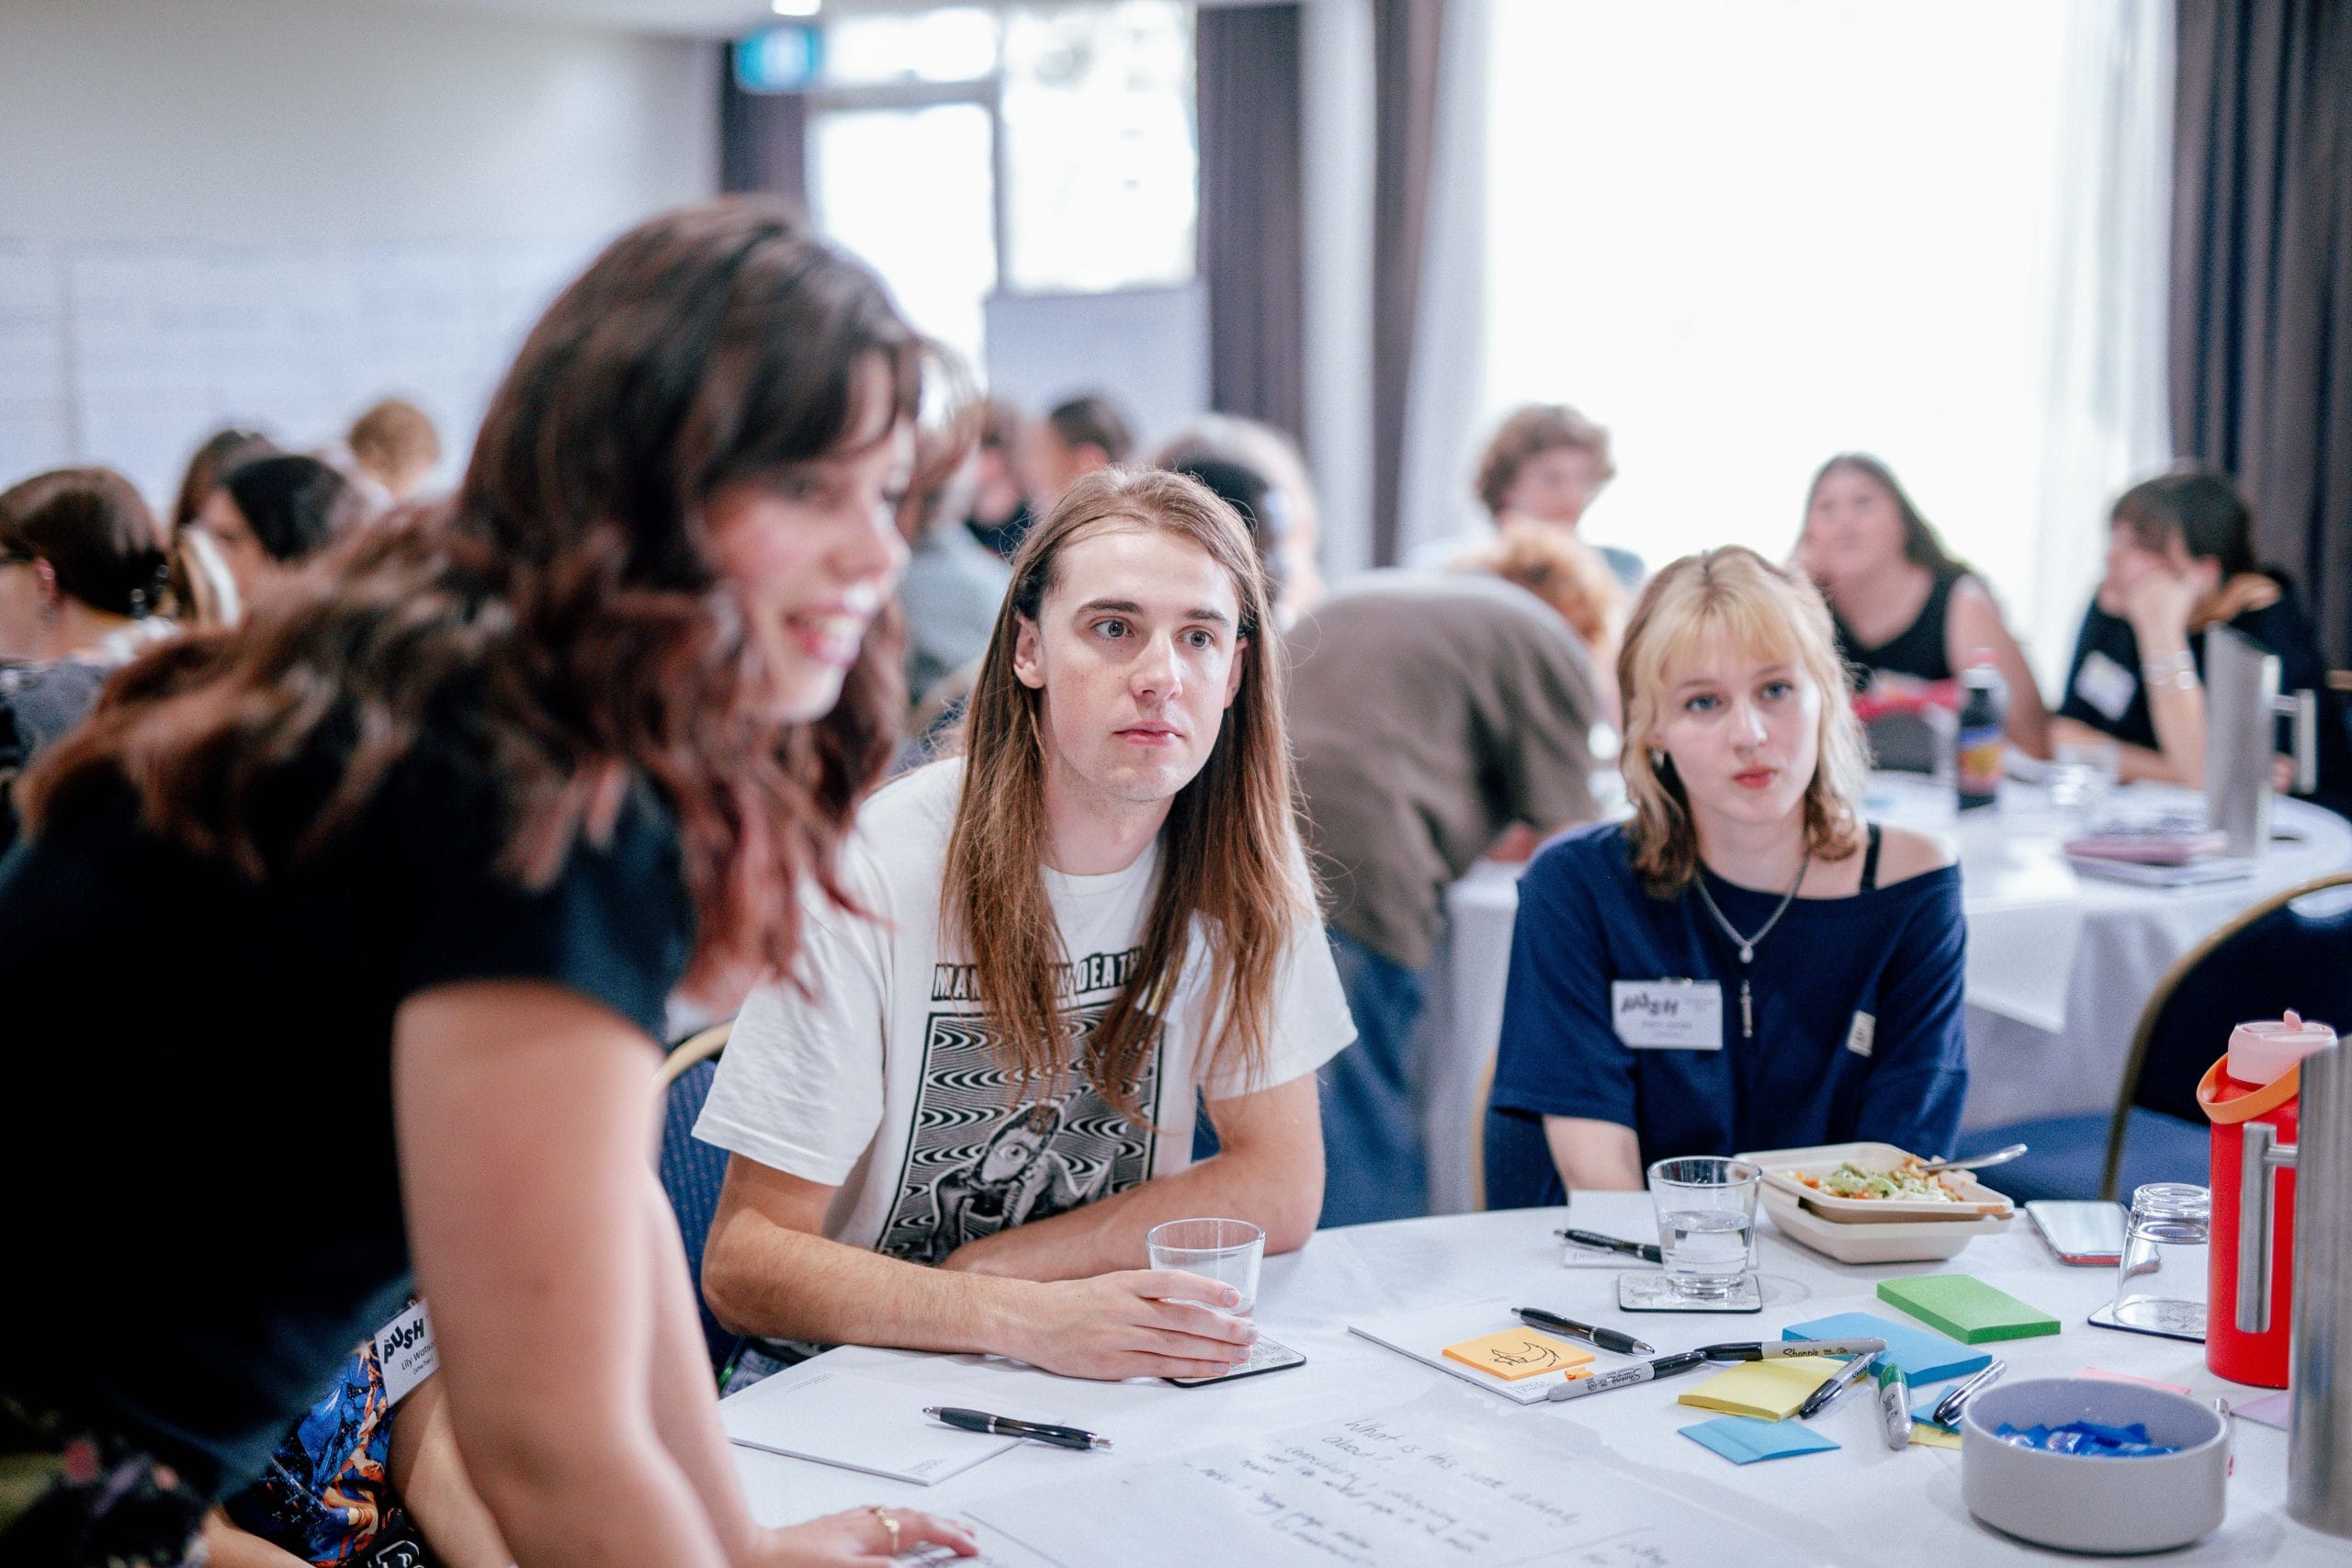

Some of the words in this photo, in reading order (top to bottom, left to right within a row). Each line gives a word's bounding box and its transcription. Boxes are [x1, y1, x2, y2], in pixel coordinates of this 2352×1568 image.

[383, 1318, 424, 1364] PUSH
[1344, 1418, 1407, 1440] What
[1398, 1443, 1422, 1454] is
